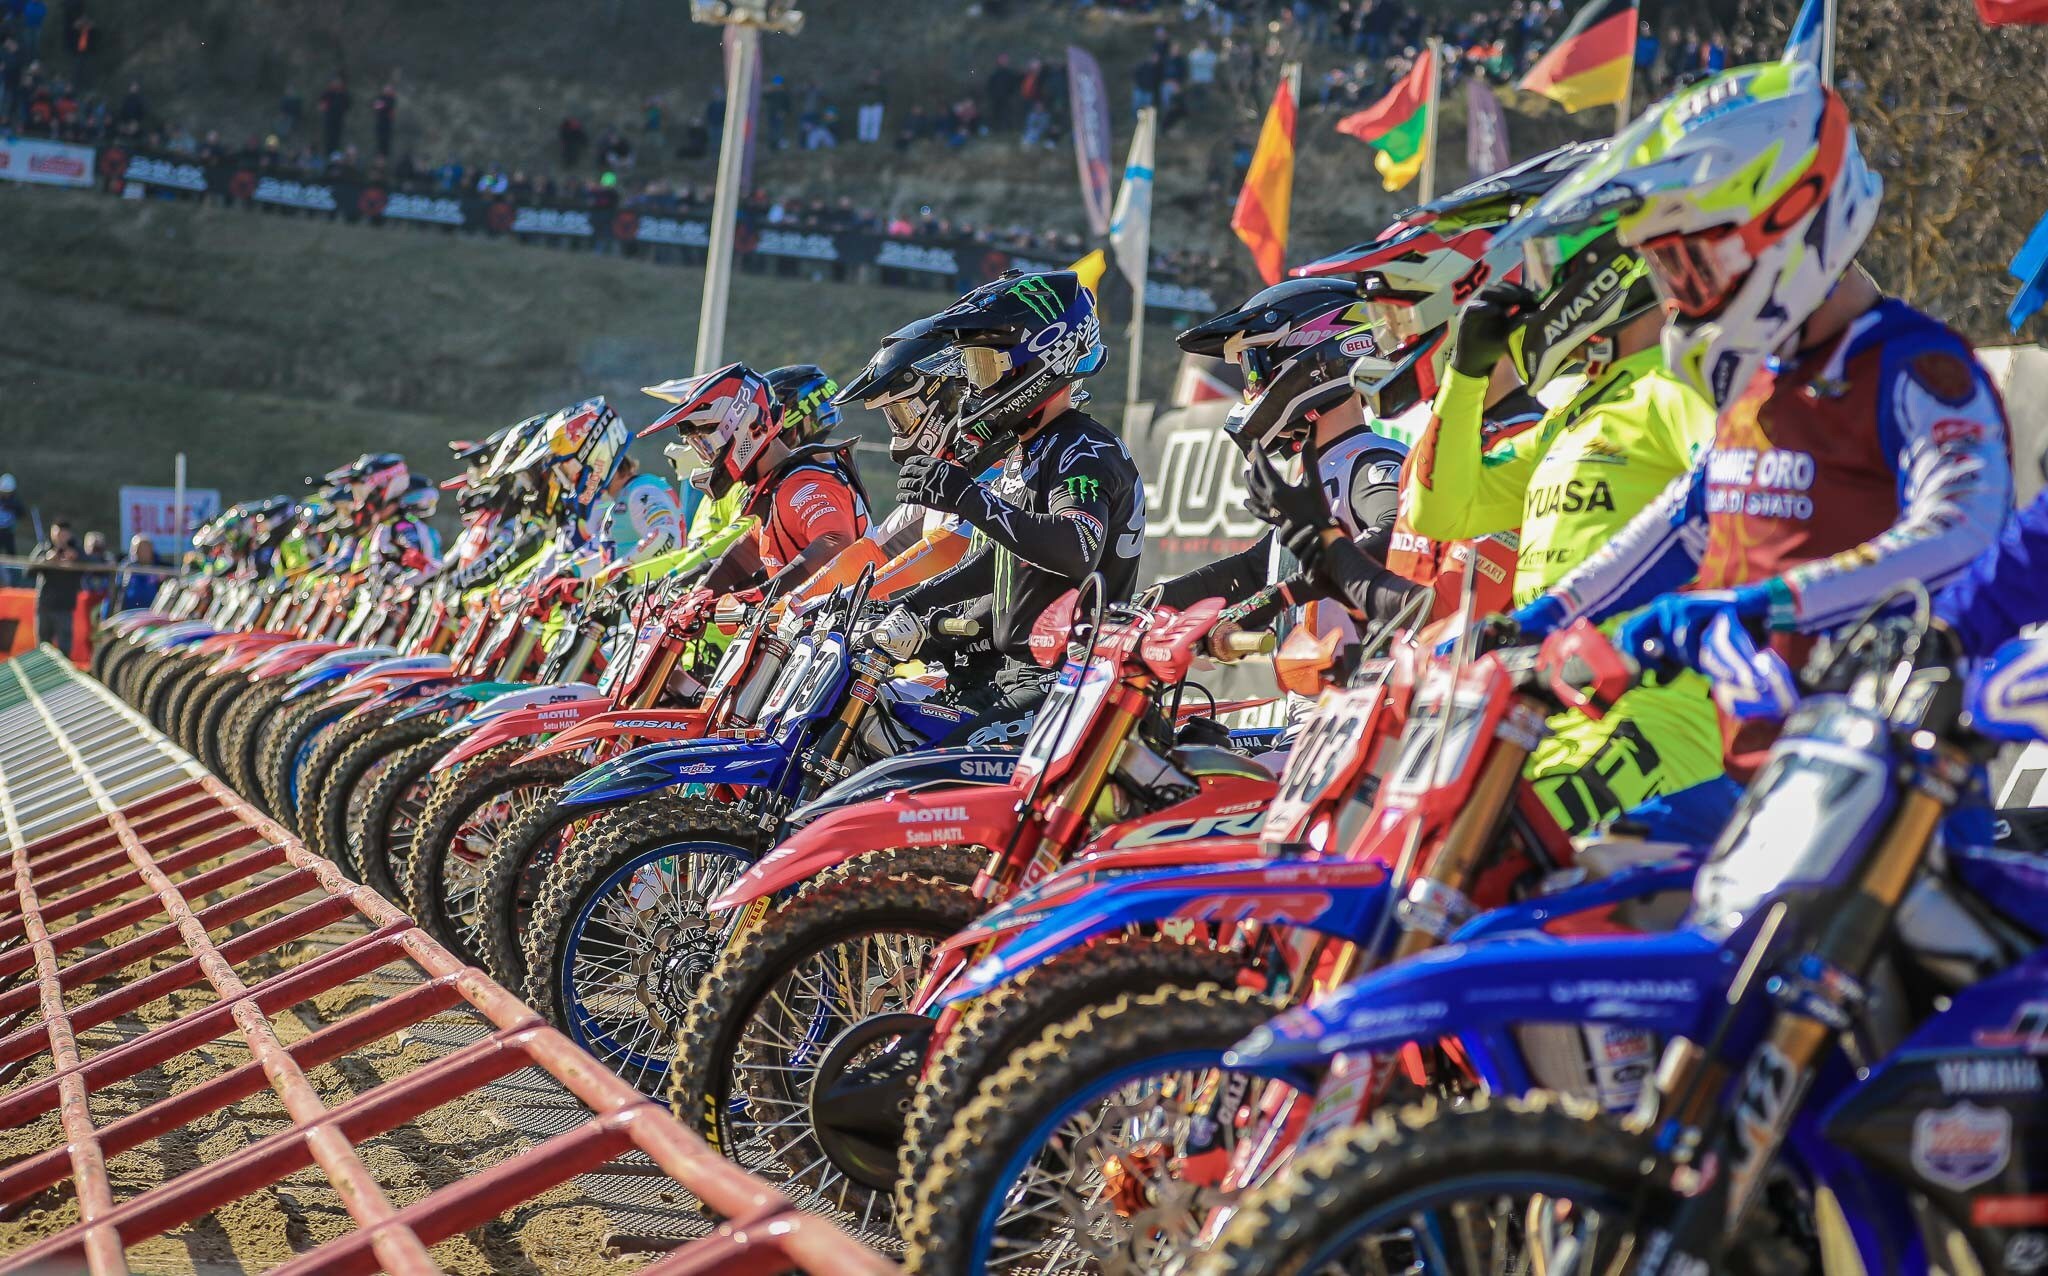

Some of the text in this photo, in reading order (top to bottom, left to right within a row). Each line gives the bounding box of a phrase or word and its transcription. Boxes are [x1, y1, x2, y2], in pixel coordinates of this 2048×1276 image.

[1346, 339, 1374, 352] BELL
[999, 372, 1052, 415] MONSTER
[1758, 450, 1815, 490] ORO
[1526, 480, 1616, 520] YUASA
[538, 709, 580, 719] MOTUL
[614, 719, 689, 731] KOSAK
[680, 764, 716, 774] VERTEX
[898, 806, 969, 823] MOTUL
[906, 830, 932, 843] Satu
